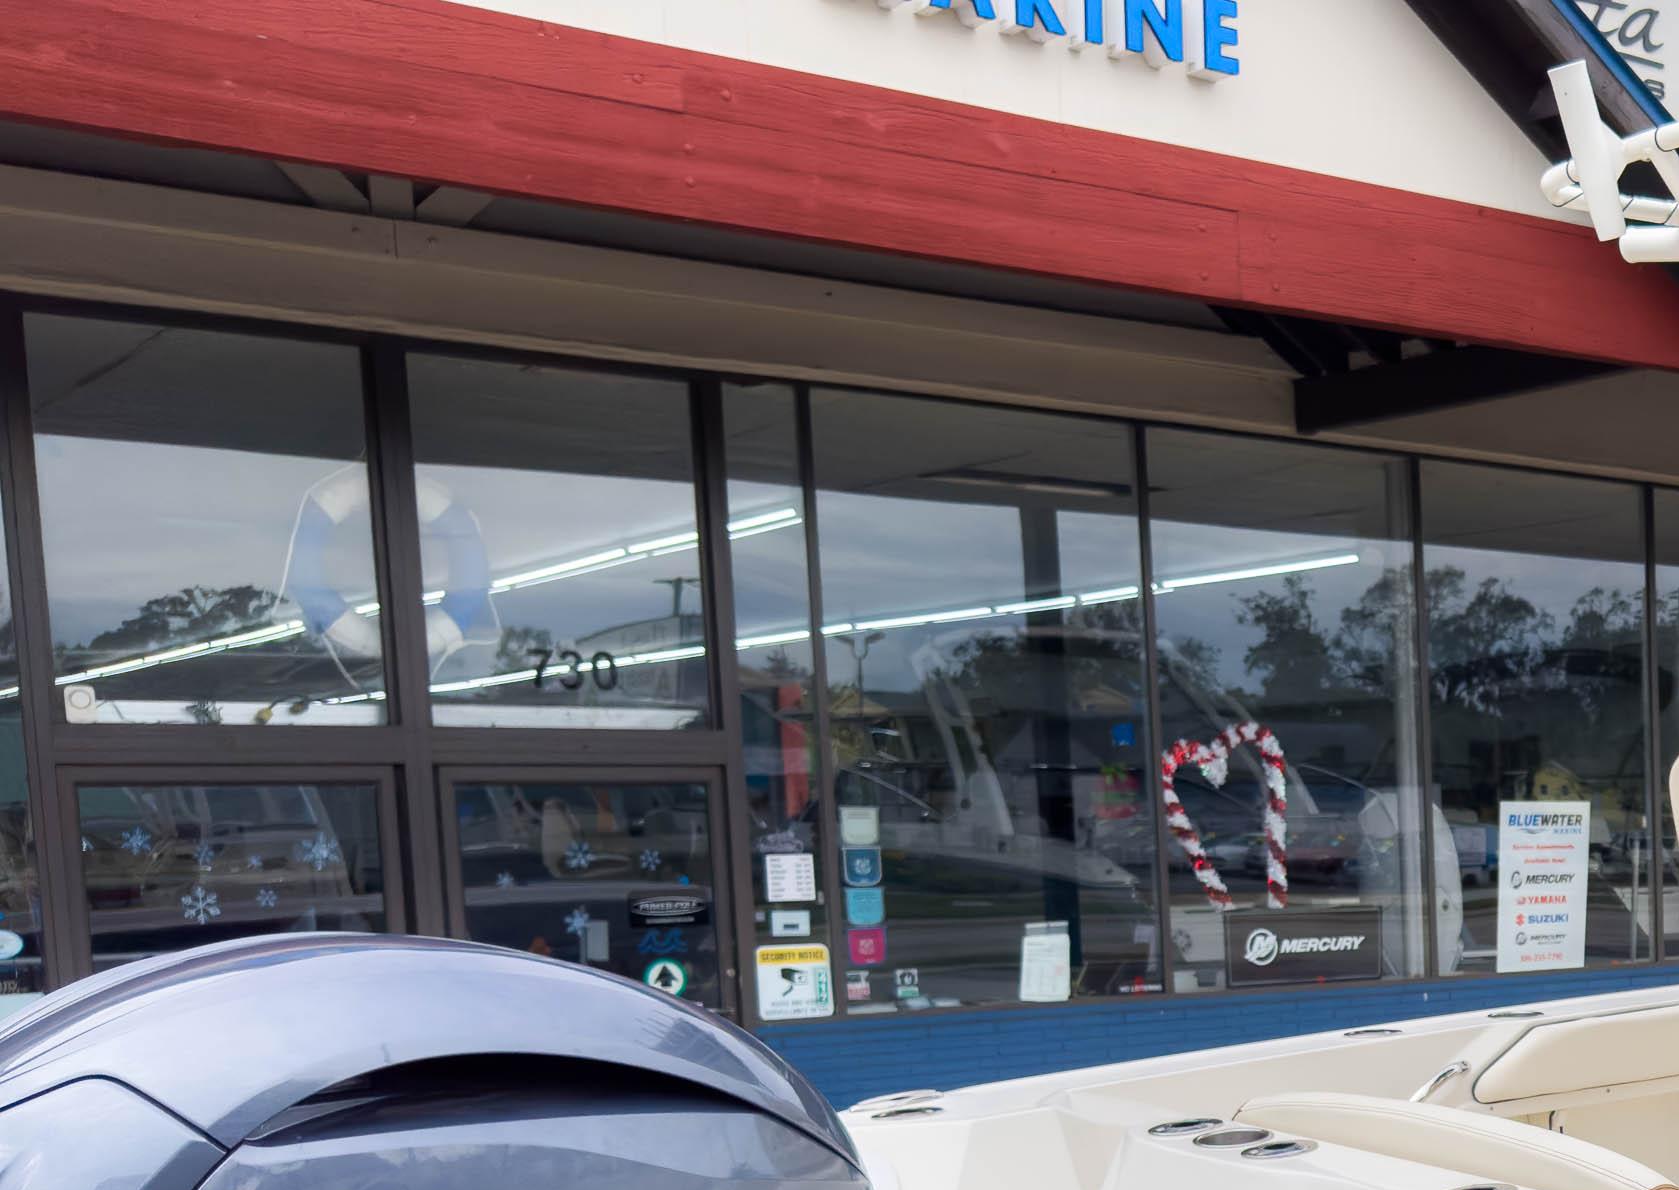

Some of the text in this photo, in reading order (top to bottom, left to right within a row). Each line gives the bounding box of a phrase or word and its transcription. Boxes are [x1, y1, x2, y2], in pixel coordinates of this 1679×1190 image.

[526, 648, 618, 691] 730
[1508, 814, 1583, 827] BLUEWATER
[1525, 873, 1576, 885] MERCURY
[1528, 895, 1567, 905] YAMAHA
[1527, 913, 1569, 925] SUZUKI
[1279, 936, 1366, 954] MERCURY
